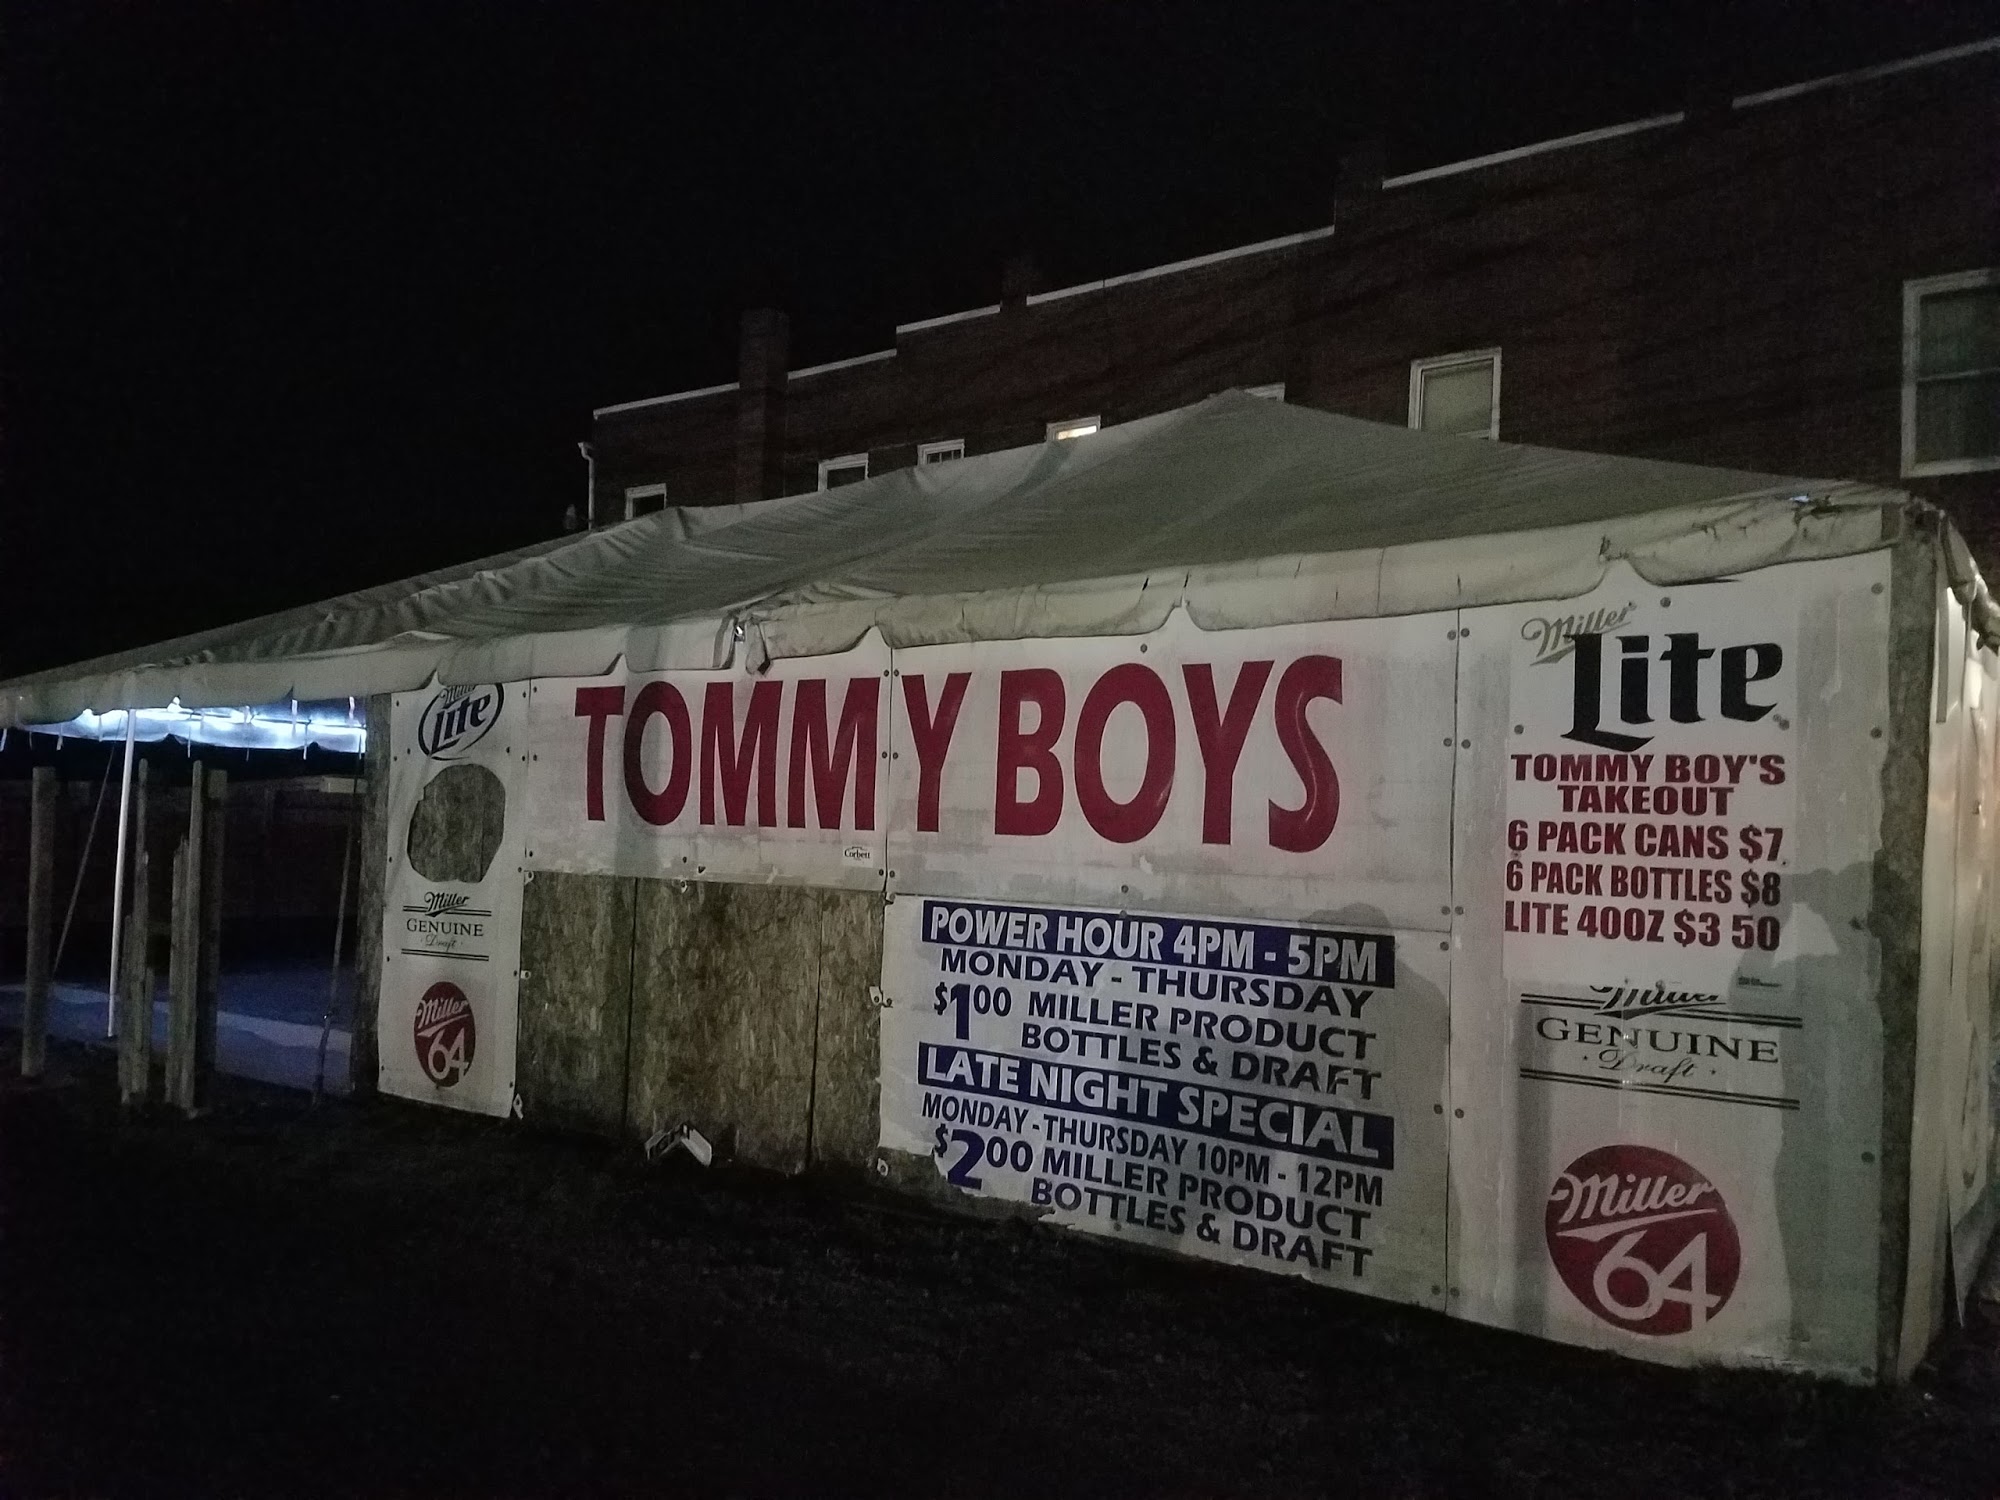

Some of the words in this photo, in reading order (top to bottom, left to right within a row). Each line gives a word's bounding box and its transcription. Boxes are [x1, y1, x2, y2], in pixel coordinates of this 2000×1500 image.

[1521, 602, 1635, 666] Miller
[1561, 632, 1783, 752] Lite
[430, 693, 491, 756] Lite
[574, 672, 972, 833] TOMMY
[994, 654, 1343, 854] BOYS
[1510, 753, 1654, 784] TOMMY
[1664, 753, 1786, 786] BOY'S
[1557, 784, 1735, 817] TAKEOUT
[1507, 819, 1529, 853] 6
[1537, 820, 1627, 856] PACK
[1634, 823, 1730, 861] CANS
[1738, 823, 1784, 864] $7
[423, 891, 471, 918] Miller
[1505, 859, 1524, 893] 6
[1530, 861, 1603, 897] PACK
[1610, 865, 1733, 904] BOTTLES
[1740, 868, 1782, 909] $8
[406, 917, 485, 937] GENUINE
[930, 905, 1049, 951] POWER
[1056, 915, 1165, 962] HOUR
[1172, 925, 1256, 971] 4PM
[1287, 933, 1378, 983] 5PM
[1504, 900, 1570, 936] LITE
[940, 947, 1104, 988] MONDAY
[1131, 965, 1375, 1020] THURSDAY
[416, 997, 472, 1037] Miller
[1028, 990, 1160, 1033] MILLER
[1169, 1006, 1377, 1060] PRODUCT
[1536, 1016, 1779, 1064] GENUINE
[427, 1027, 470, 1084] 64
[1021, 1022, 1181, 1070] BOTTLES
[1192, 1045, 1219, 1077] &
[1230, 1050, 1382, 1100] DRAFT
[1597, 1048, 1699, 1083] Draft
[926, 1046, 1021, 1095] LATE
[1029, 1062, 1169, 1119] NIGHT
[1177, 1085, 1379, 1160] SPECIAL
[921, 1091, 1030, 1135] MONDAY
[1043, 1113, 1189, 1167] THURSDAY
[1197, 1141, 1271, 1186] 10PM
[1297, 1161, 1384, 1207] 12PM
[1042, 1146, 1169, 1198] MILLER
[1178, 1171, 1372, 1241] PRODUCT
[1551, 1172, 1718, 1240] Miller
[1030, 1176, 1187, 1236] BOTTLES
[1196, 1212, 1221, 1245] &
[1232, 1219, 1374, 1278] DRAFT
[1592, 1229, 1722, 1331] 64
